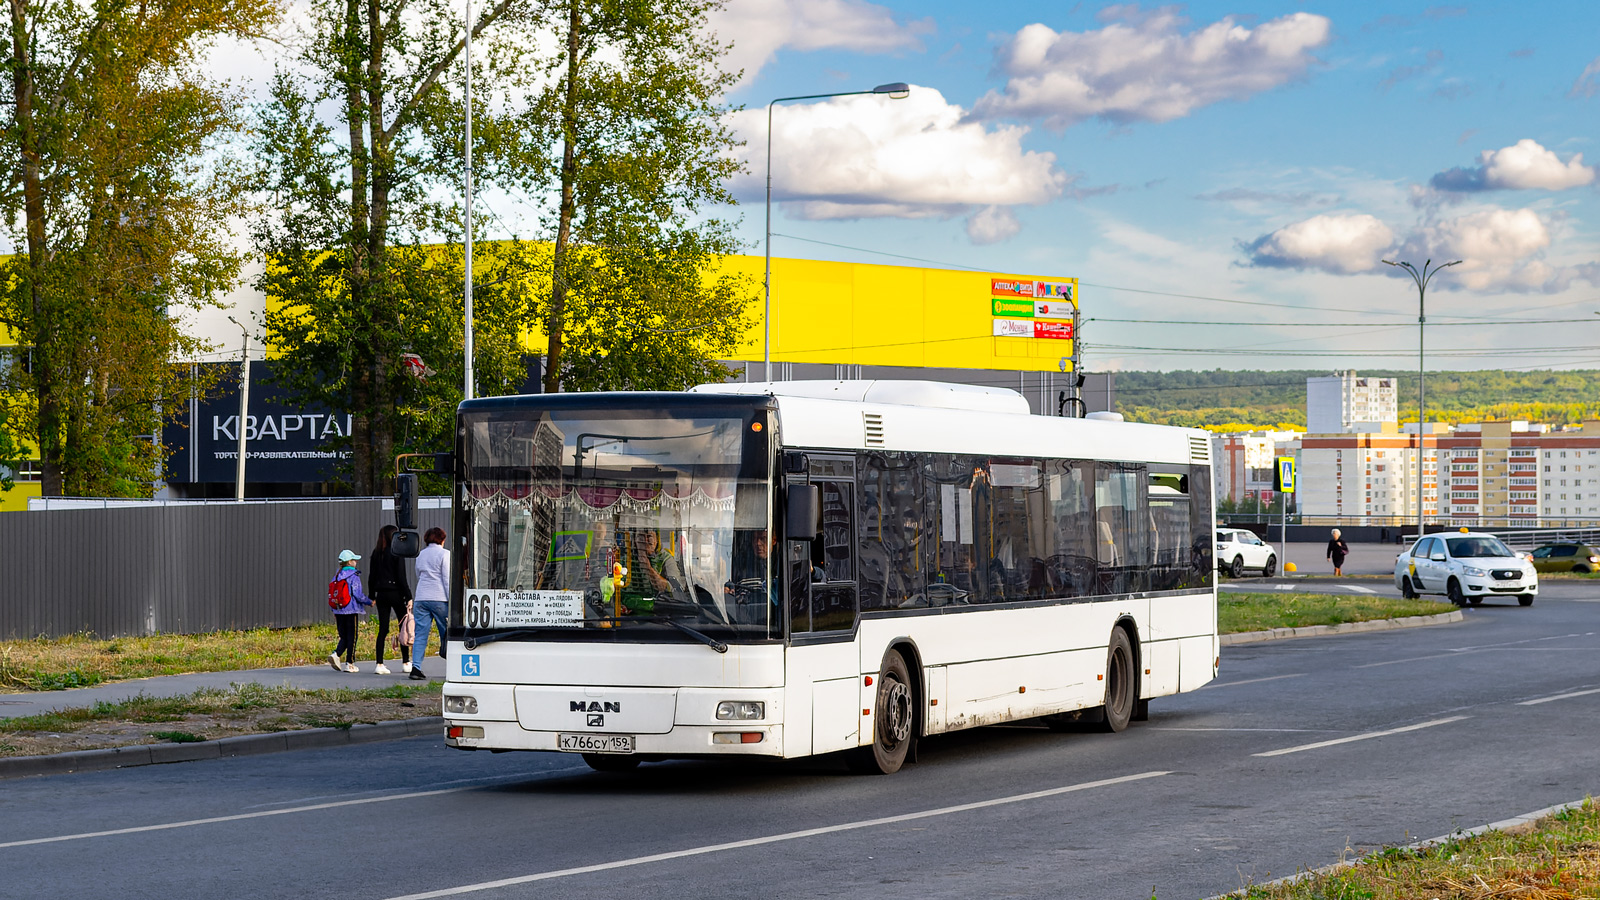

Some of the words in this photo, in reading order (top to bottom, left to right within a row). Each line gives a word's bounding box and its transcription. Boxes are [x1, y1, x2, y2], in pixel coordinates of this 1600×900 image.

[994, 281, 1014, 291] АПТЕКА
[214, 450, 337, 459] ТОРГОО-РАЗВЛЕКАТЕЛЬНЫЙ
[497, 592, 512, 600] АРБ.
[513, 592, 541, 601] ЗАСТАВА
[467, 594, 491, 628] 66
[569, 701, 620, 713] MAN
[564, 735, 608, 749] К766СУ
[610, 737, 628, 747] 159
